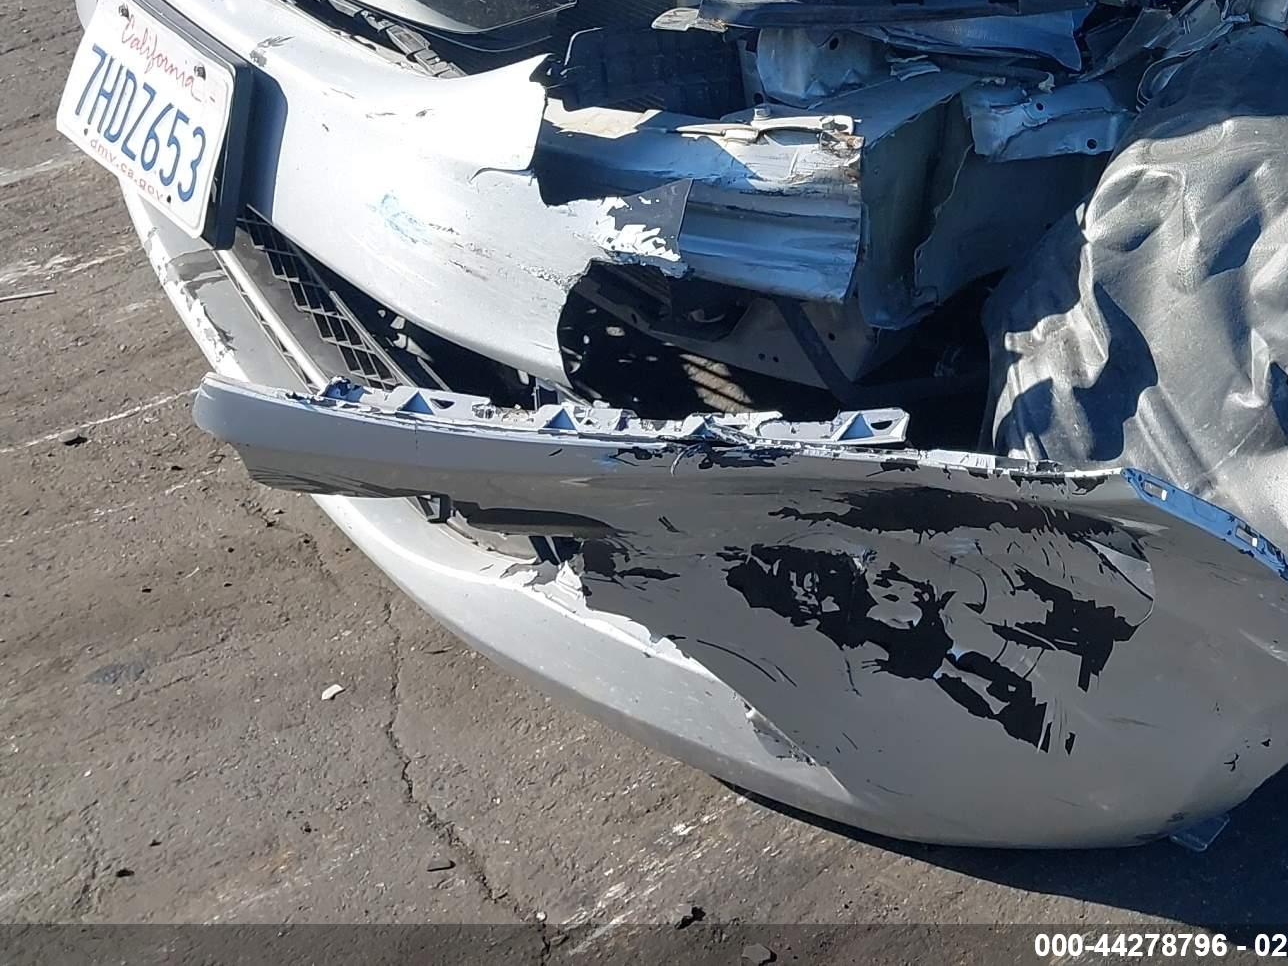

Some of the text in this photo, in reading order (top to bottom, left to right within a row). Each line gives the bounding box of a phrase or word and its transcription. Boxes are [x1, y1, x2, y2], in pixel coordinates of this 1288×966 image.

[120, 14, 203, 102] California
[74, 42, 207, 203] 7HDZ653
[90, 137, 165, 202] dmv.ca.gov
